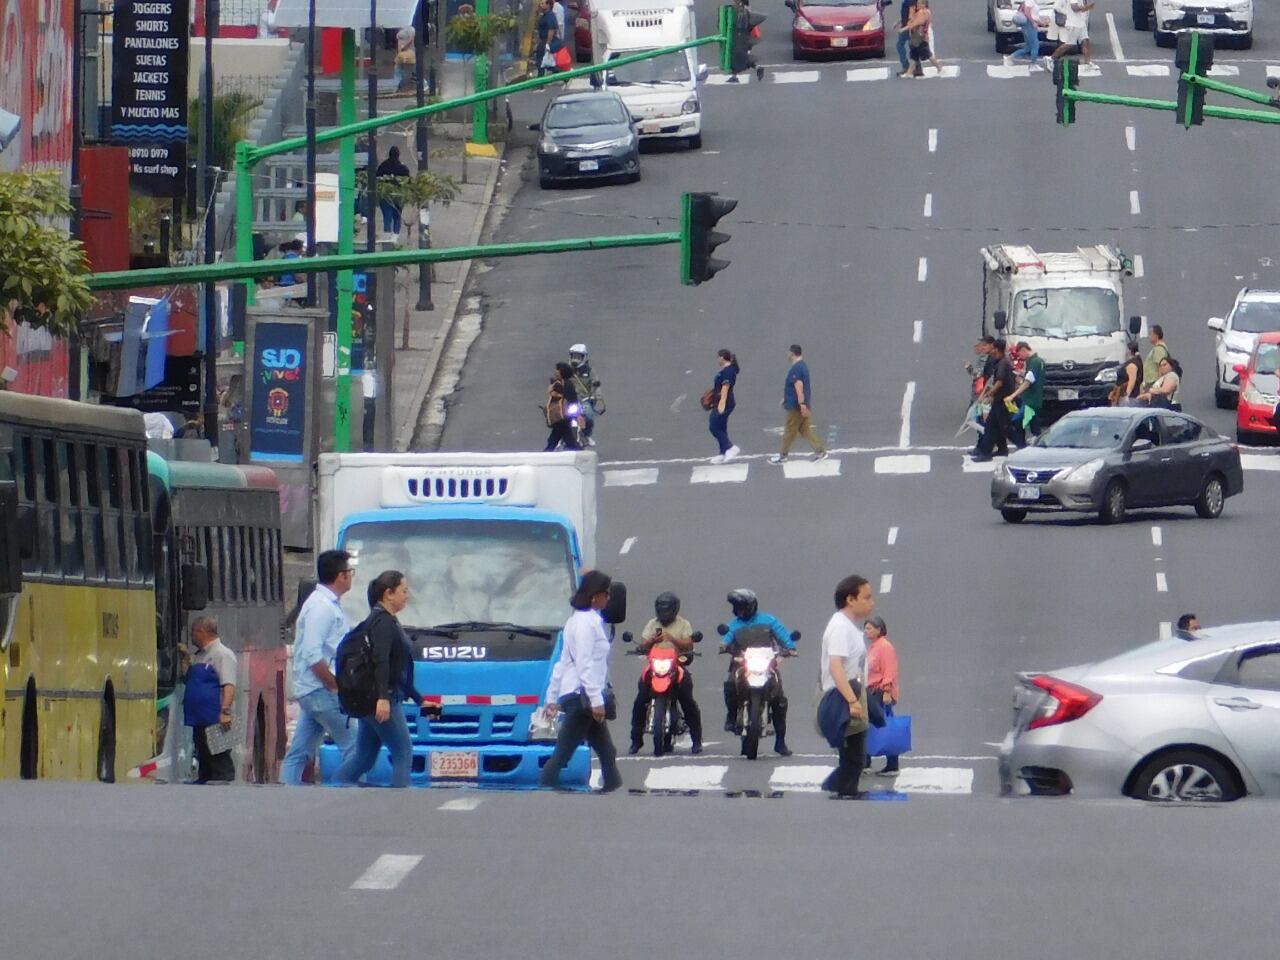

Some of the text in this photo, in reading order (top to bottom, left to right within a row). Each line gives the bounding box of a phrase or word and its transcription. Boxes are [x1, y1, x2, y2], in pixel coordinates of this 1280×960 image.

[133, 2, 172, 14] JOGGERS
[136, 20, 169, 32] SHORTS
[124, 37, 179, 49] PANTALONES
[136, 55, 167, 66] SUETAS
[132, 72, 169, 84] JACKETS
[135, 89, 166, 101] TENNIS
[121, 106, 180, 119] Y MUCHO MAS
[160, 164, 178, 177] shop
[423, 646, 486, 659] ISUZU
